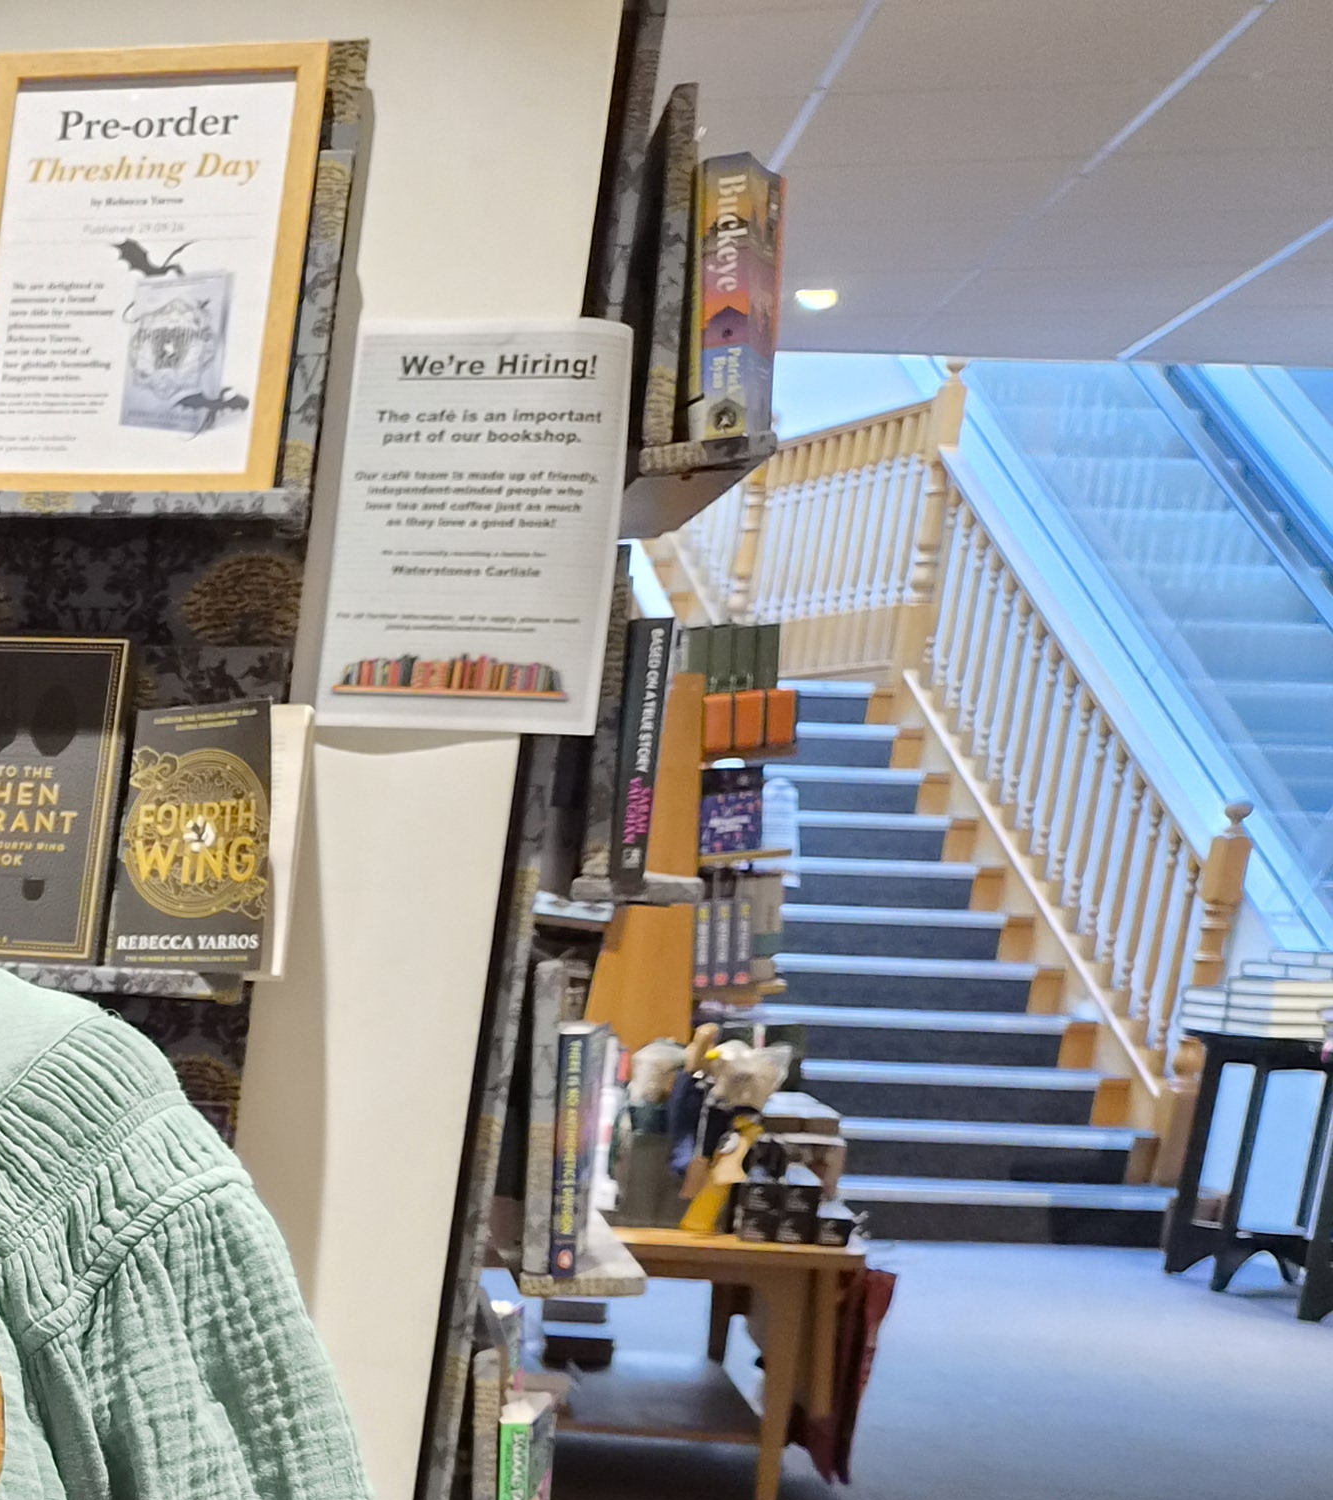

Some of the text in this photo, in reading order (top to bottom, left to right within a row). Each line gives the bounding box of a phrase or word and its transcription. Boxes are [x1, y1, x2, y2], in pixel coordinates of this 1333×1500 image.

[57, 106, 239, 141] Pre-order
[28, 152, 260, 188] Threshing Day
[706, 174, 748, 292] Buckeye
[400, 354, 598, 379] We're Hiring!
[376, 408, 602, 426] The café is an important
[382, 429, 581, 446] part of our bookshop.
[647, 628, 665, 669] BASED
[635, 732, 653, 773] STORY
[24, 766, 54, 779] THE
[137, 798, 256, 837] FOURTH
[135, 836, 257, 884] WING
[117, 933, 259, 951] REBECCA YARROS
